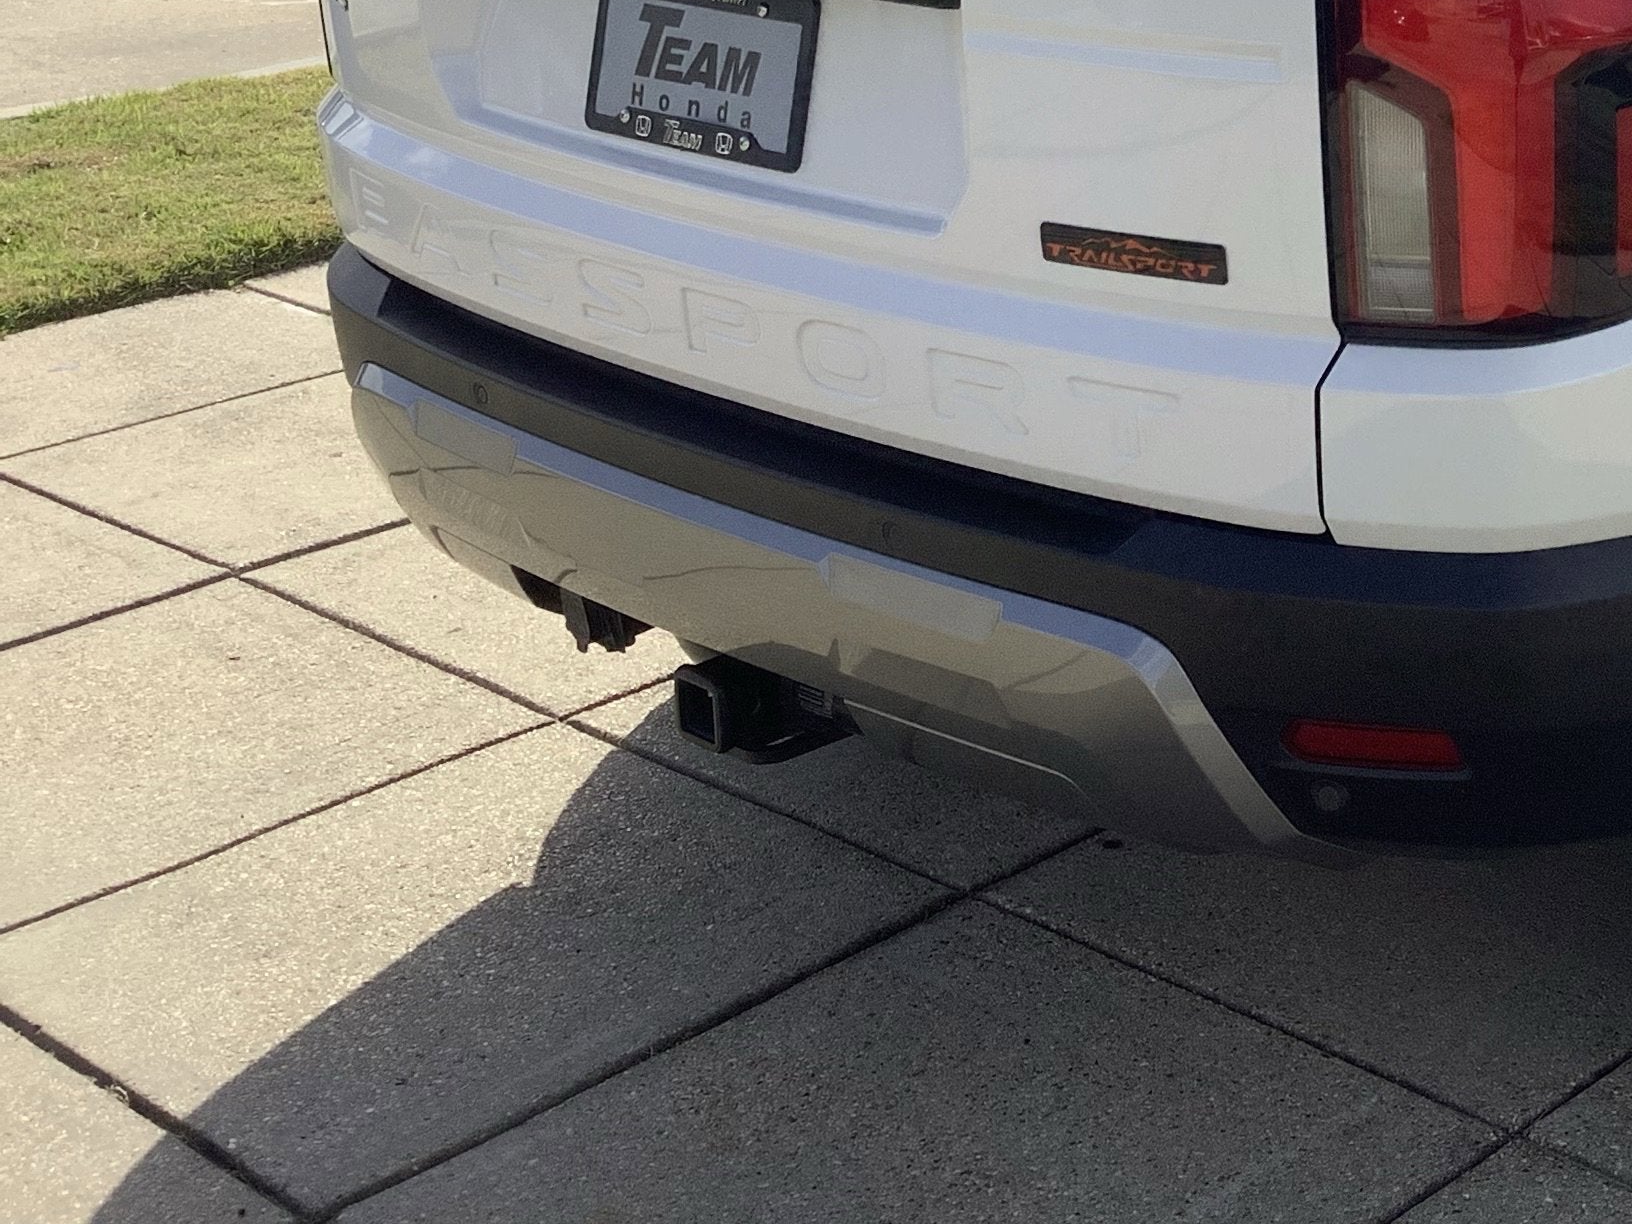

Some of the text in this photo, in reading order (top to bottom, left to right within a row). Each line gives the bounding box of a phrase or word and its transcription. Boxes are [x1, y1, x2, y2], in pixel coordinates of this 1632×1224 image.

[635, 3, 761, 97] TEAM
[632, 83, 751, 129] Honda
[663, 119, 702, 151] TEAM
[1046, 242, 1217, 279] TRAILSPORT
